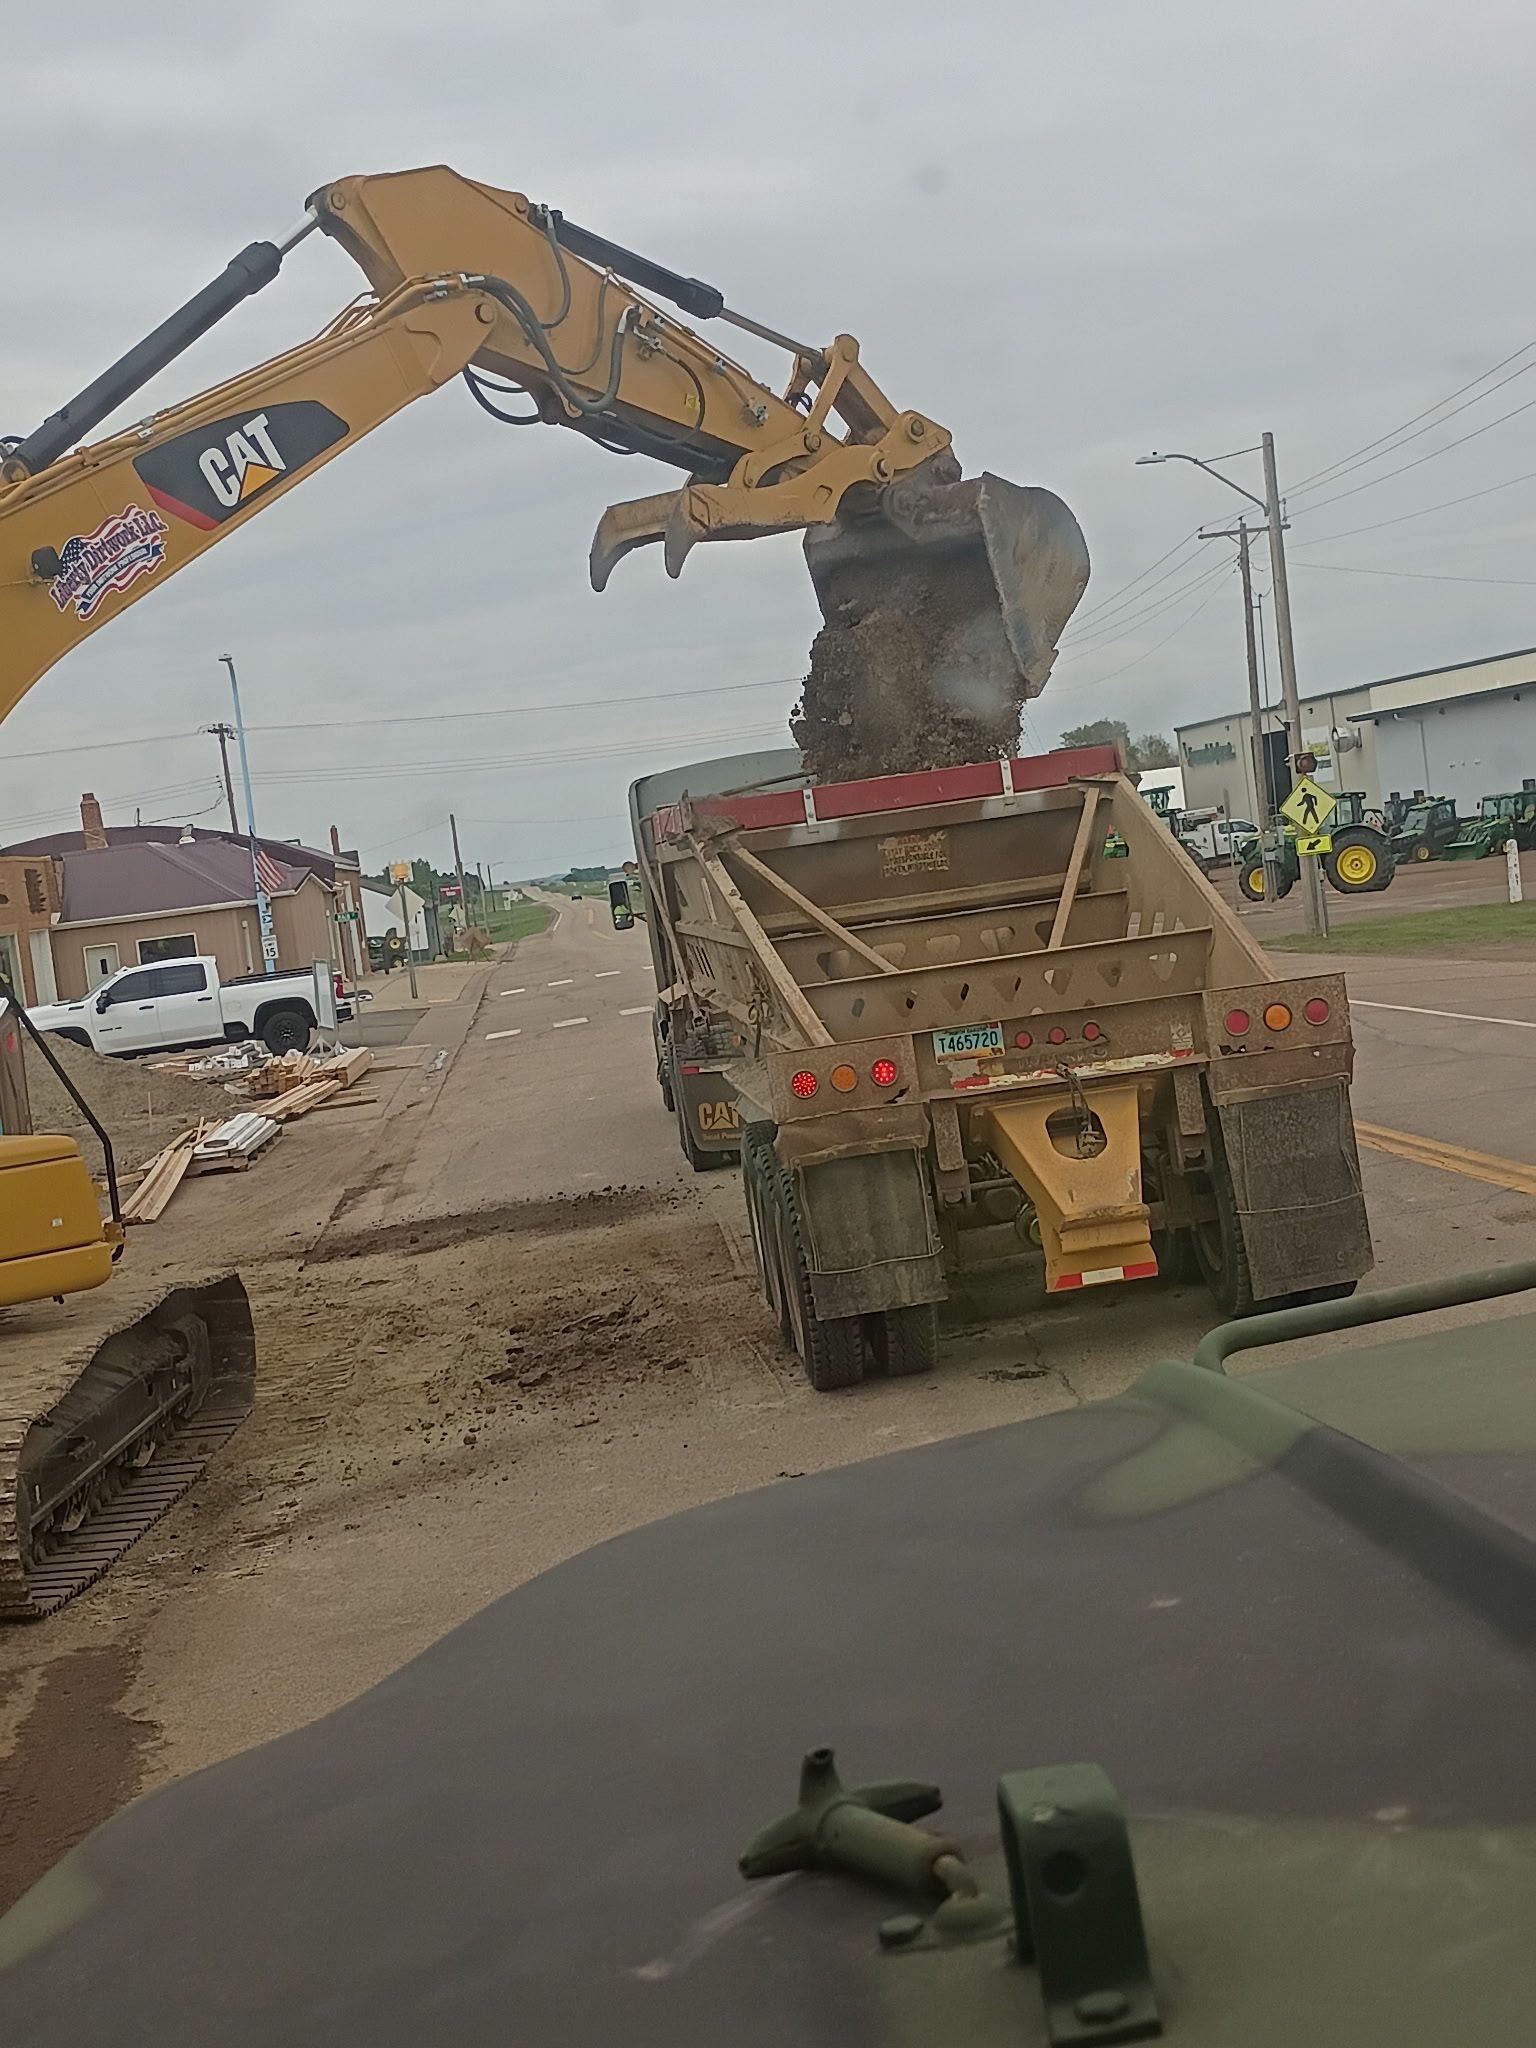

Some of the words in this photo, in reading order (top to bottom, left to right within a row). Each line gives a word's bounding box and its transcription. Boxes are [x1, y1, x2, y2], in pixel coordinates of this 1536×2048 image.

[199, 413, 286, 507] CAT
[50, 562, 91, 610] Liberty
[265, 947, 276, 957] 15
[938, 1031, 998, 1054] T465720
[698, 1101, 739, 1130] CAT
